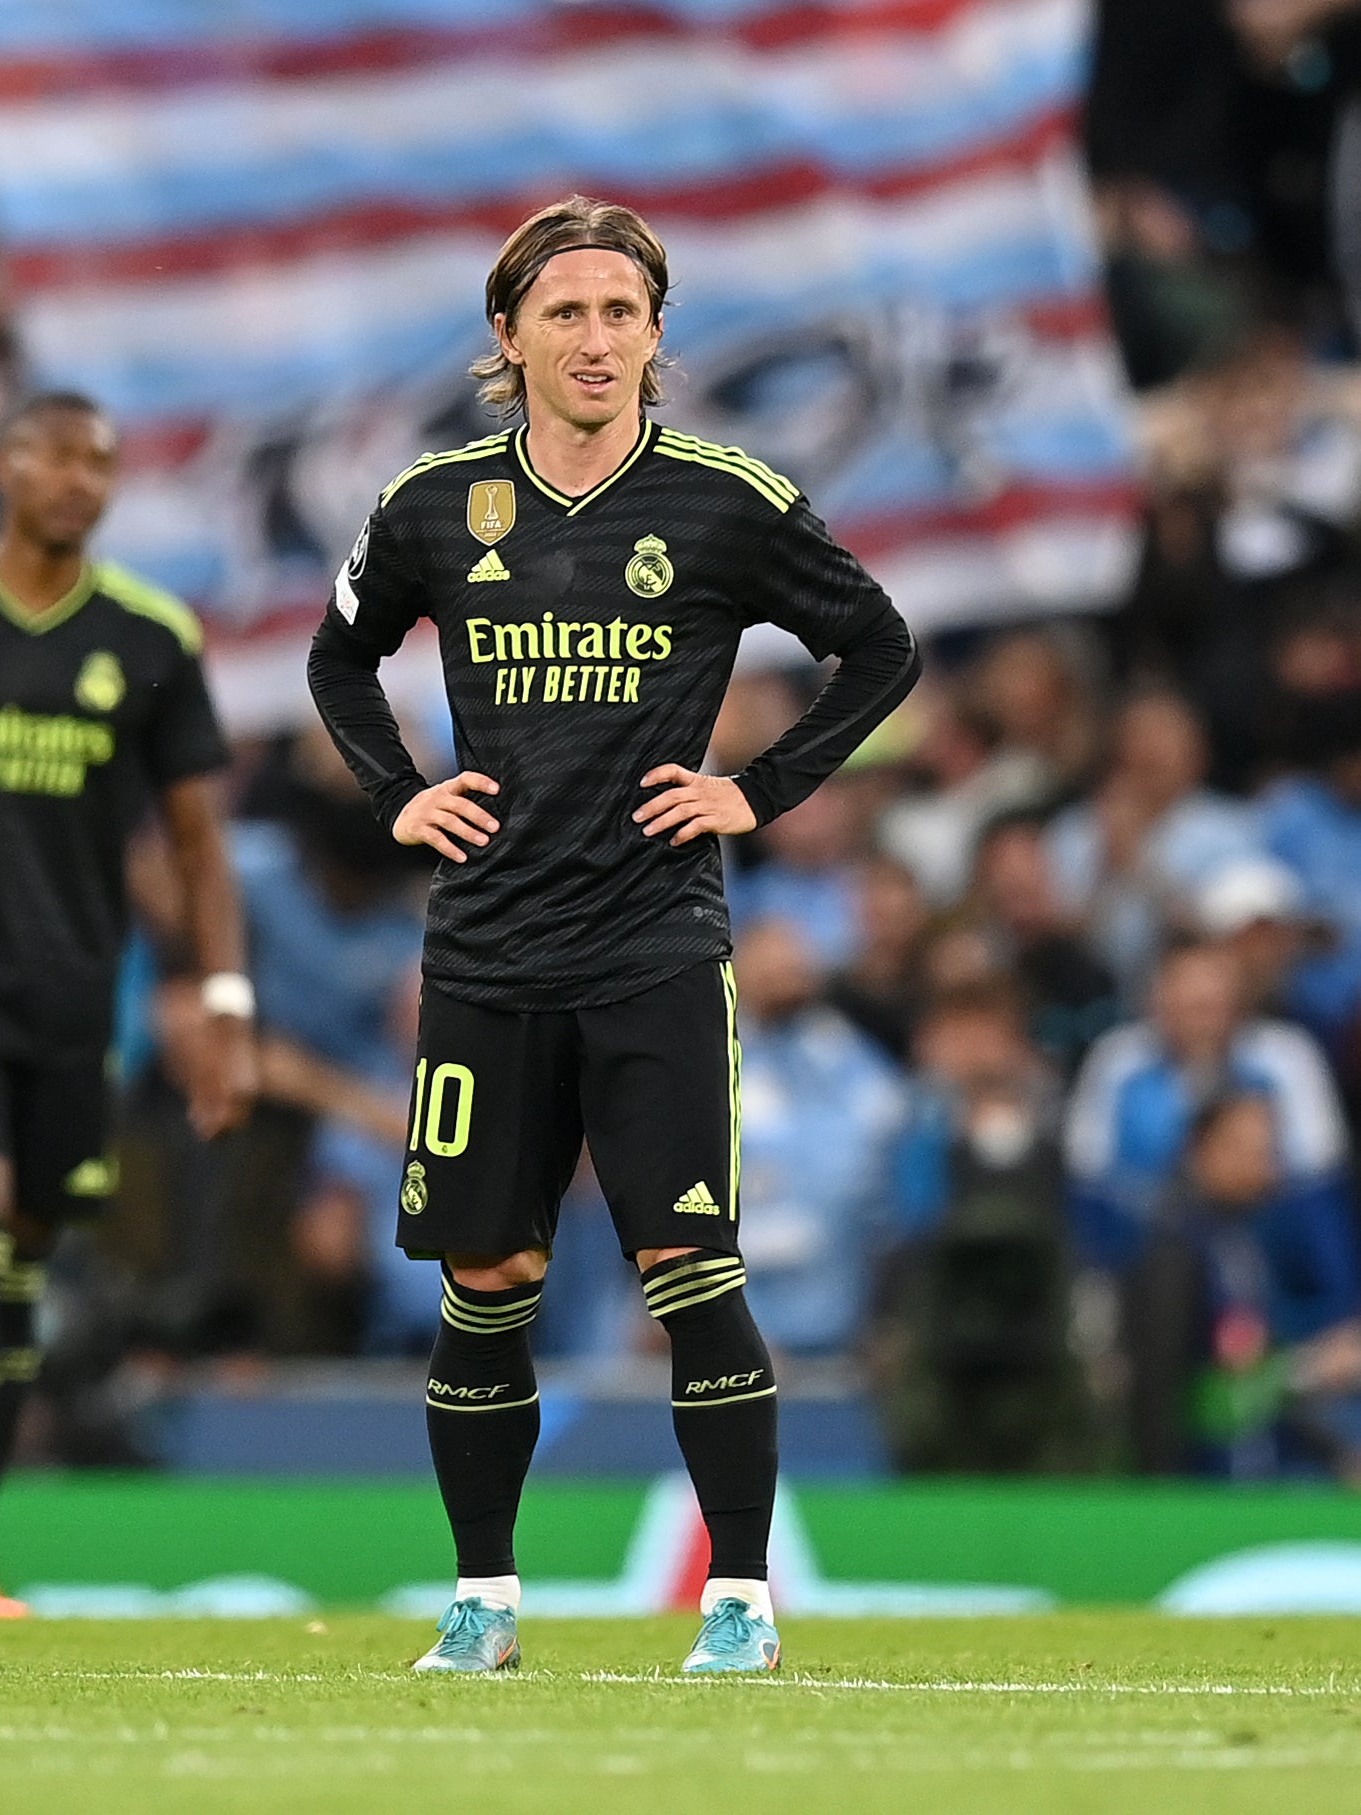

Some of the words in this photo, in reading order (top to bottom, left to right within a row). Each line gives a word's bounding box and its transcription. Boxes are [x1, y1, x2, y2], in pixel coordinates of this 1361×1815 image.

[480, 520, 502, 530] FIFA
[465, 611, 673, 664] Emirates
[495, 666, 536, 706] FLY
[542, 665, 641, 704] BETTER
[409, 1057, 475, 1157] 10
[673, 1202, 721, 1216] adidas
[427, 1377, 511, 1400] RMCF
[685, 1368, 764, 1395] RMCF
